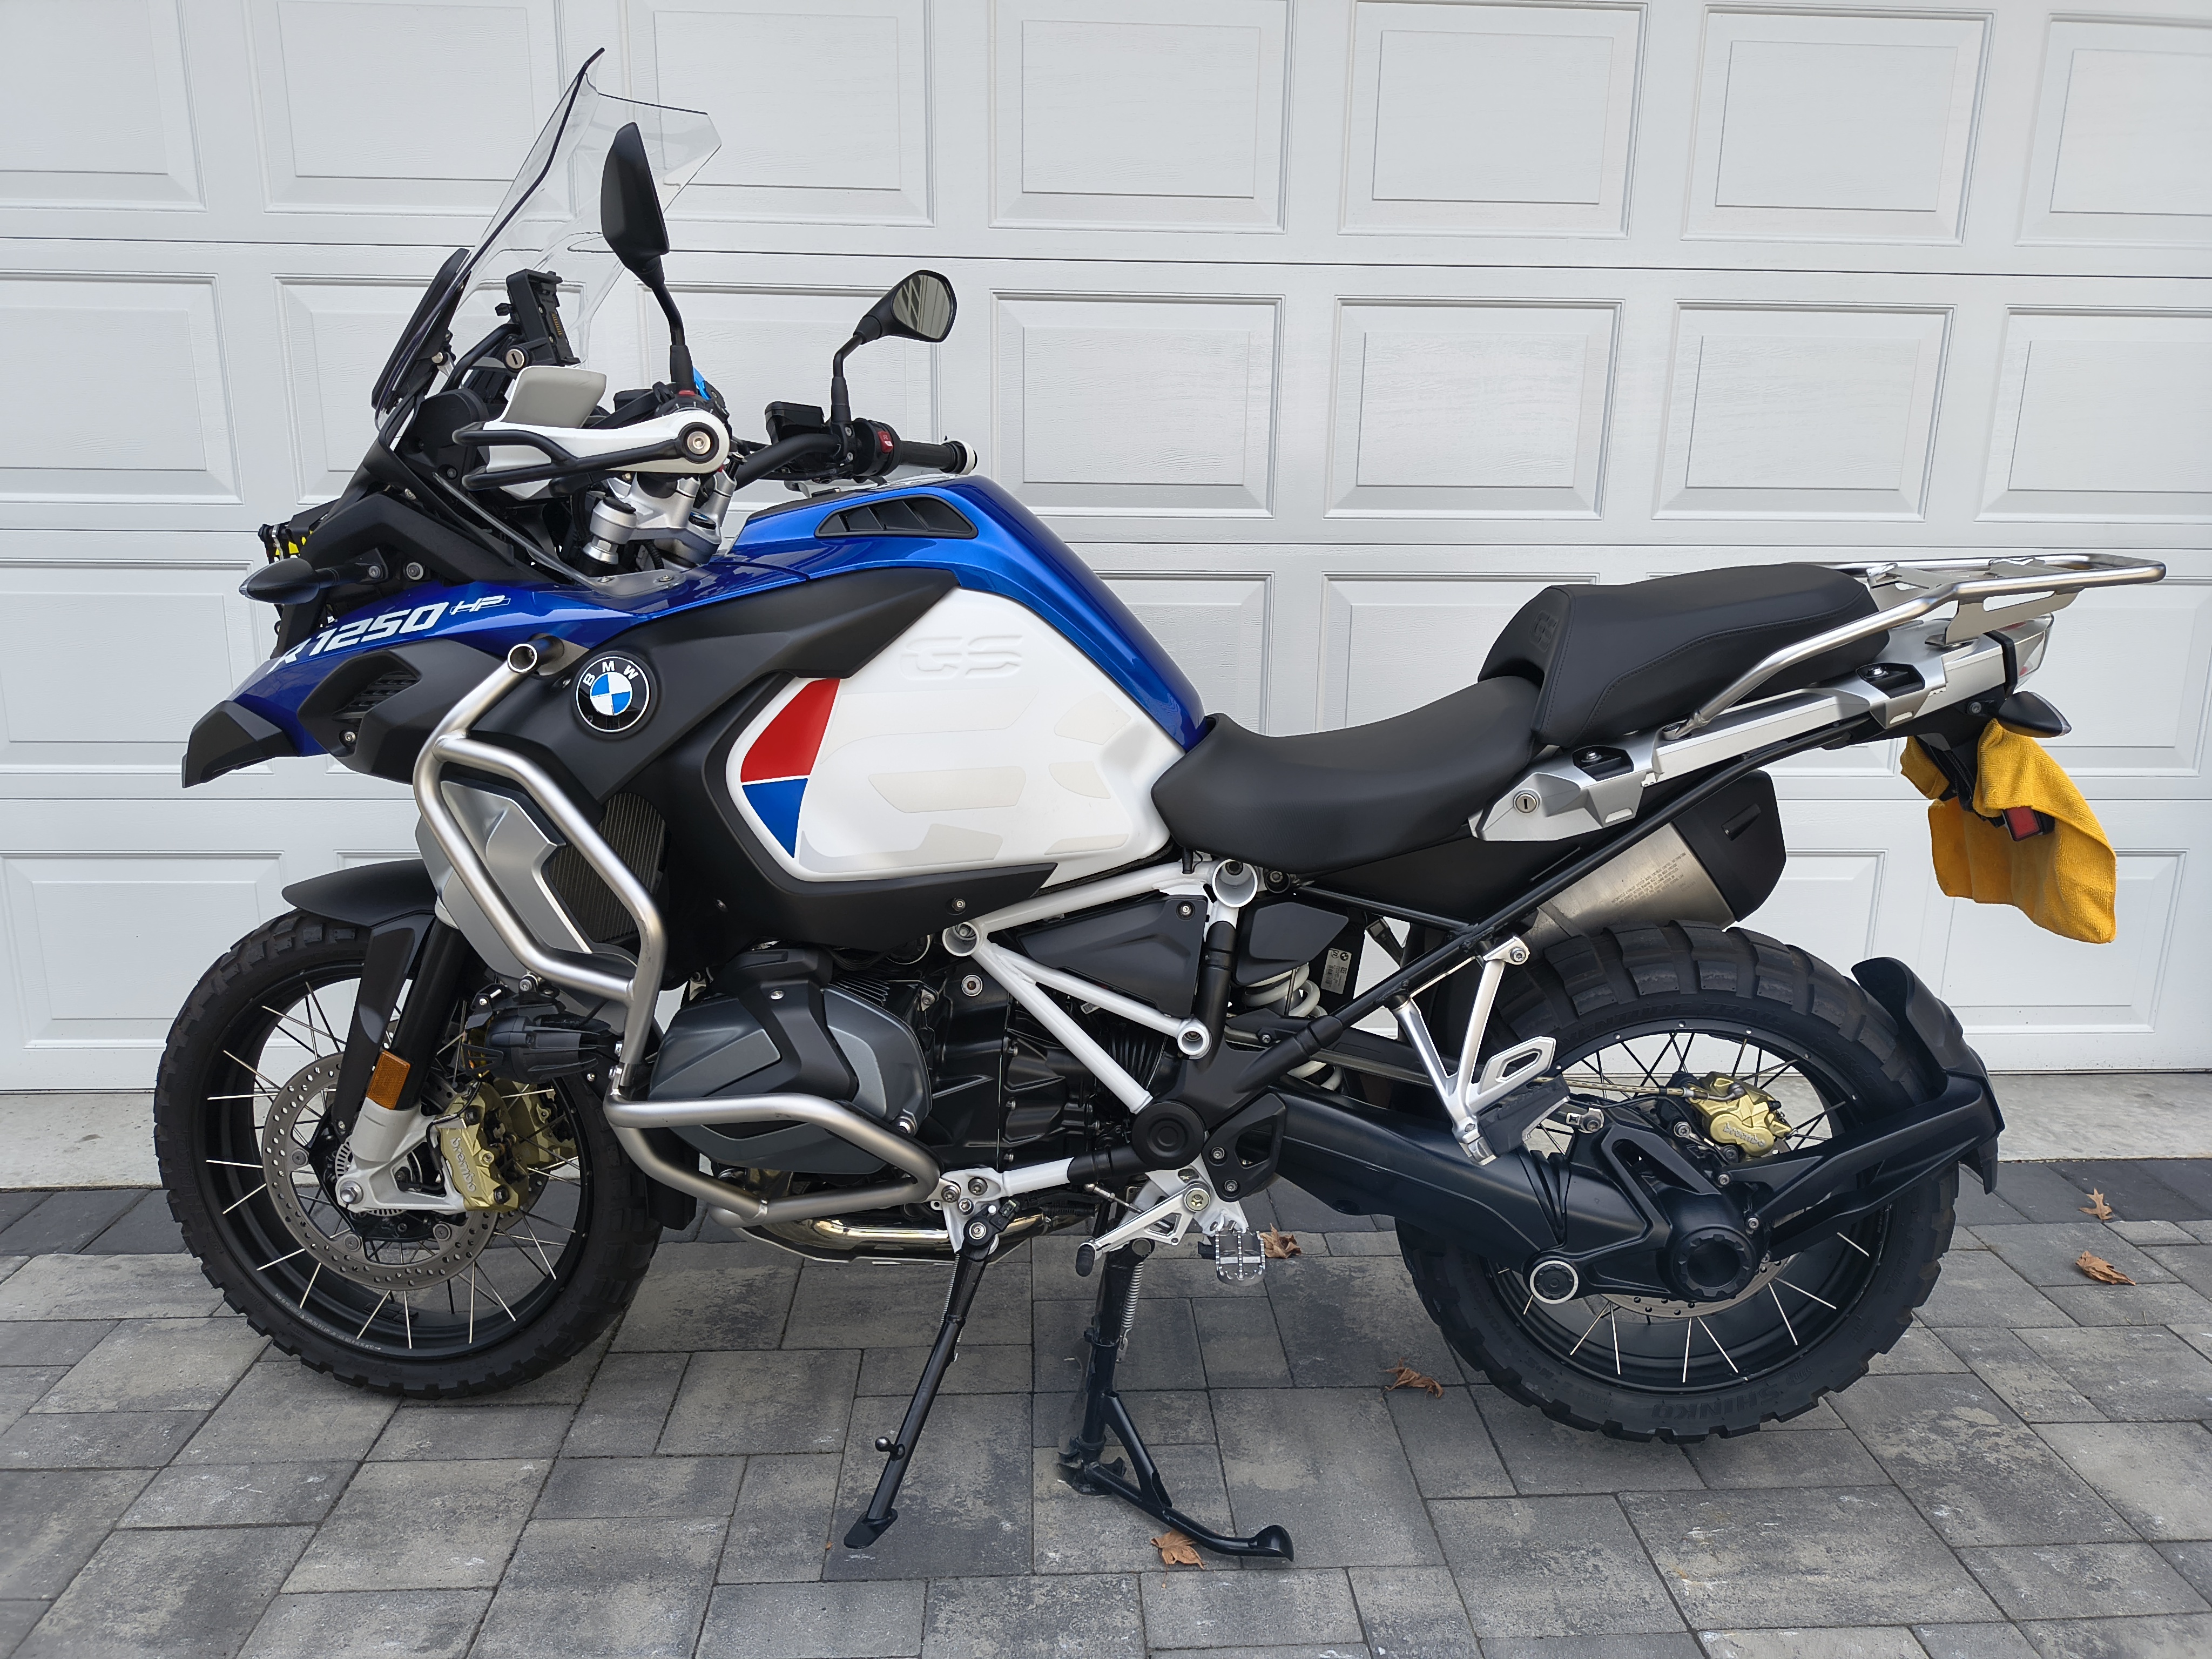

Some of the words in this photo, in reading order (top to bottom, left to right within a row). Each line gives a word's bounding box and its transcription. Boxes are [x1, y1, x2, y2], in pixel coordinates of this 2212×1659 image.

[266, 638, 312, 675] R
[308, 601, 449, 656] 1250
[449, 595, 509, 615] HP
[583, 660, 638, 686] BMW
[900, 635, 1023, 680] GS
[1723, 1122, 1765, 1148] brembo
[450, 1136, 476, 1192] brembo
[1653, 1384, 1781, 1419] SHINKO
